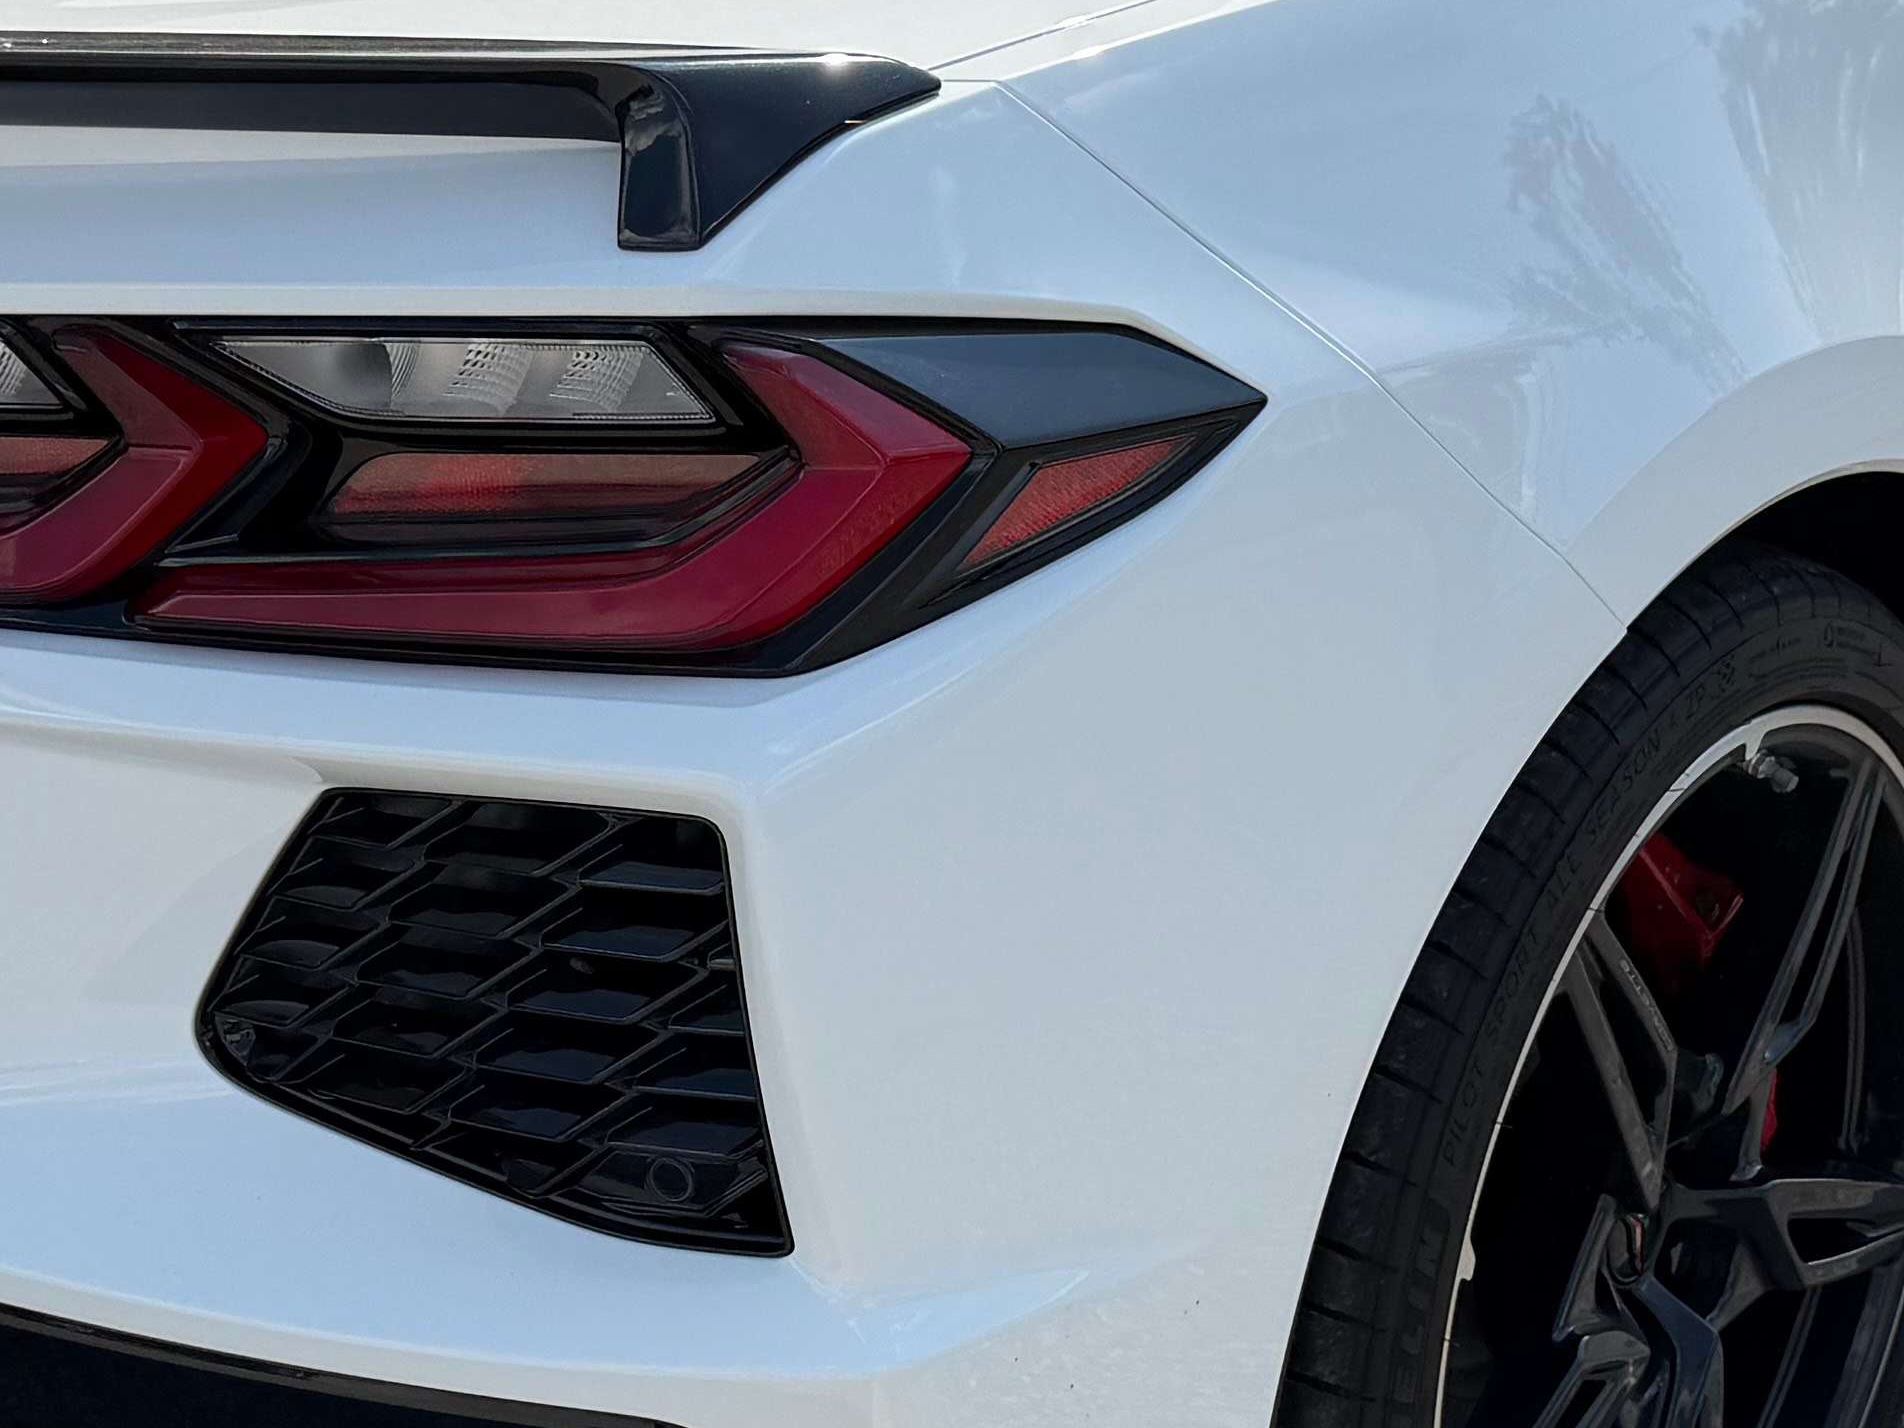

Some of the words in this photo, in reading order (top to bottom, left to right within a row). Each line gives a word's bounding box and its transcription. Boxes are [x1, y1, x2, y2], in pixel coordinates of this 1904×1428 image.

[1442, 1058, 1483, 1165] PILOT
[1487, 927, 1537, 1038] SPORT
[1585, 729, 1661, 841] SEASON
